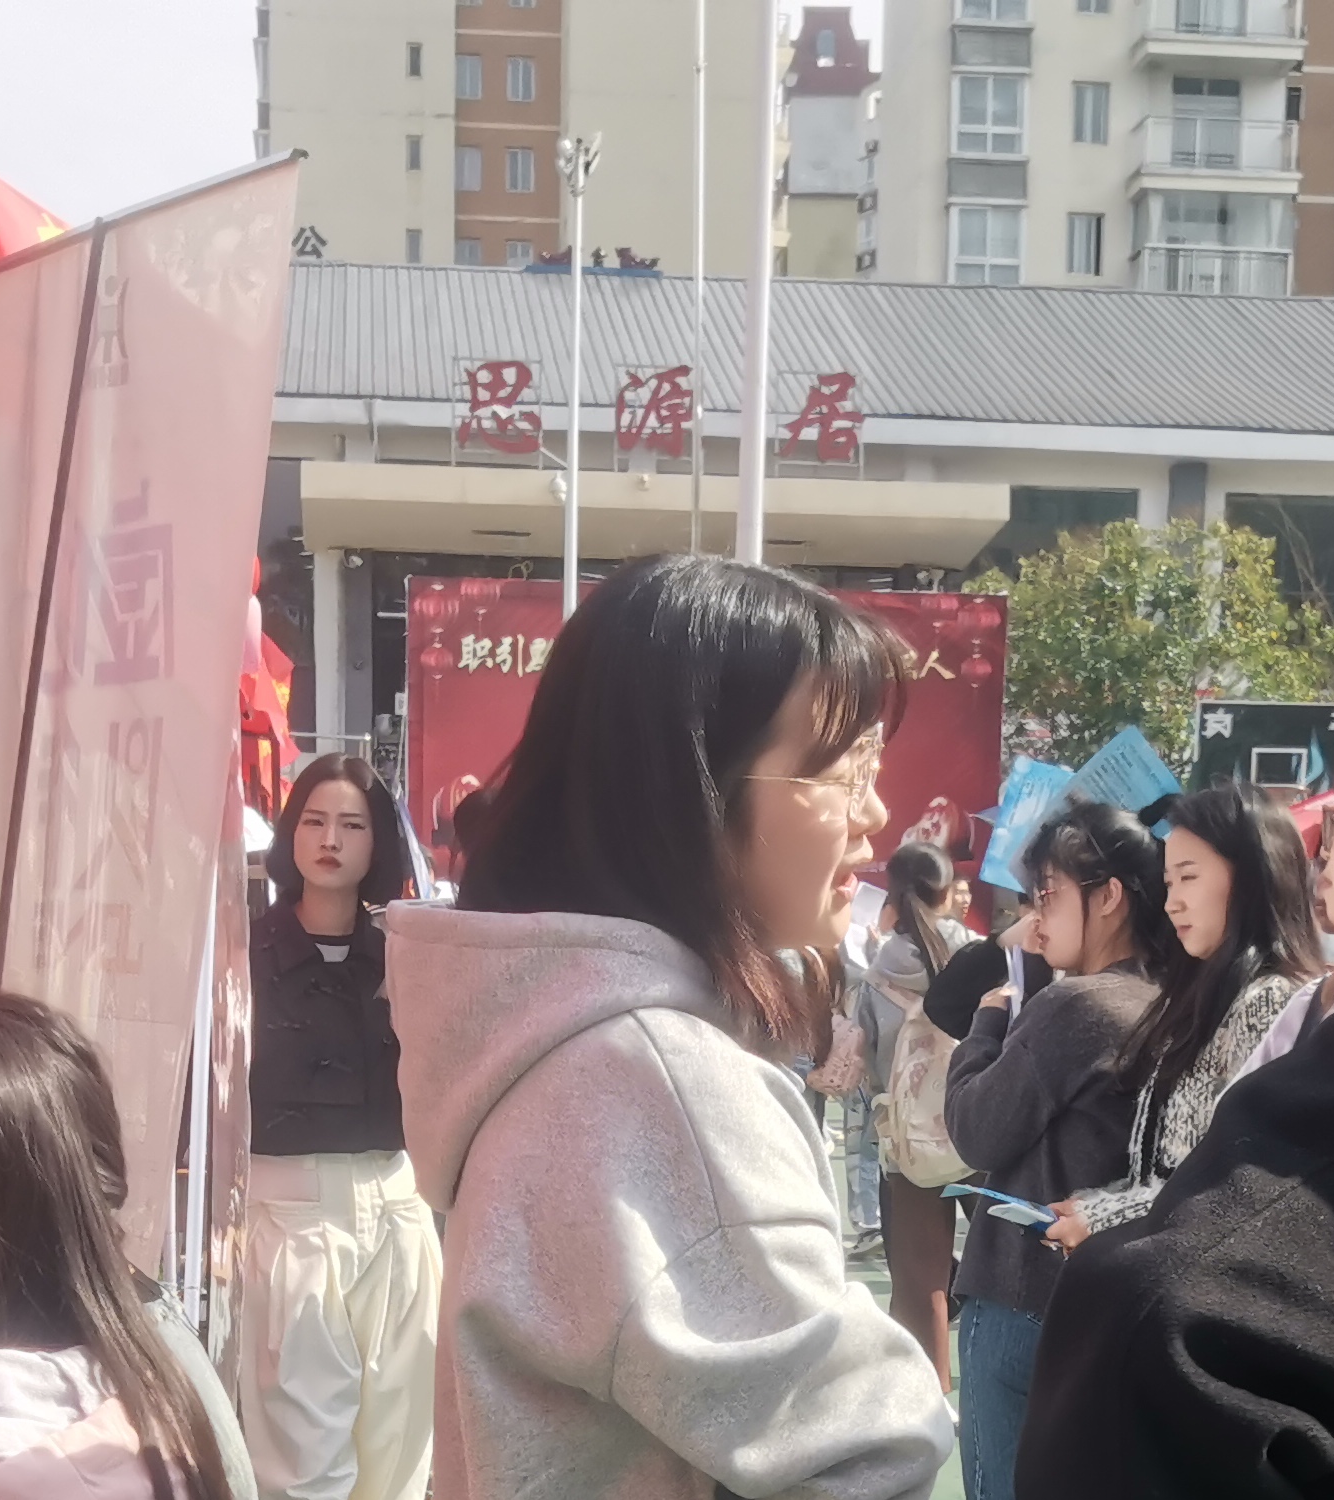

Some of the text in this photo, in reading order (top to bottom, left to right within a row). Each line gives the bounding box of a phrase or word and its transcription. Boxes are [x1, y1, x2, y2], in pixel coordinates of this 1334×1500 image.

[291, 225, 328, 259] 公
[458, 360, 865, 462] 思源居
